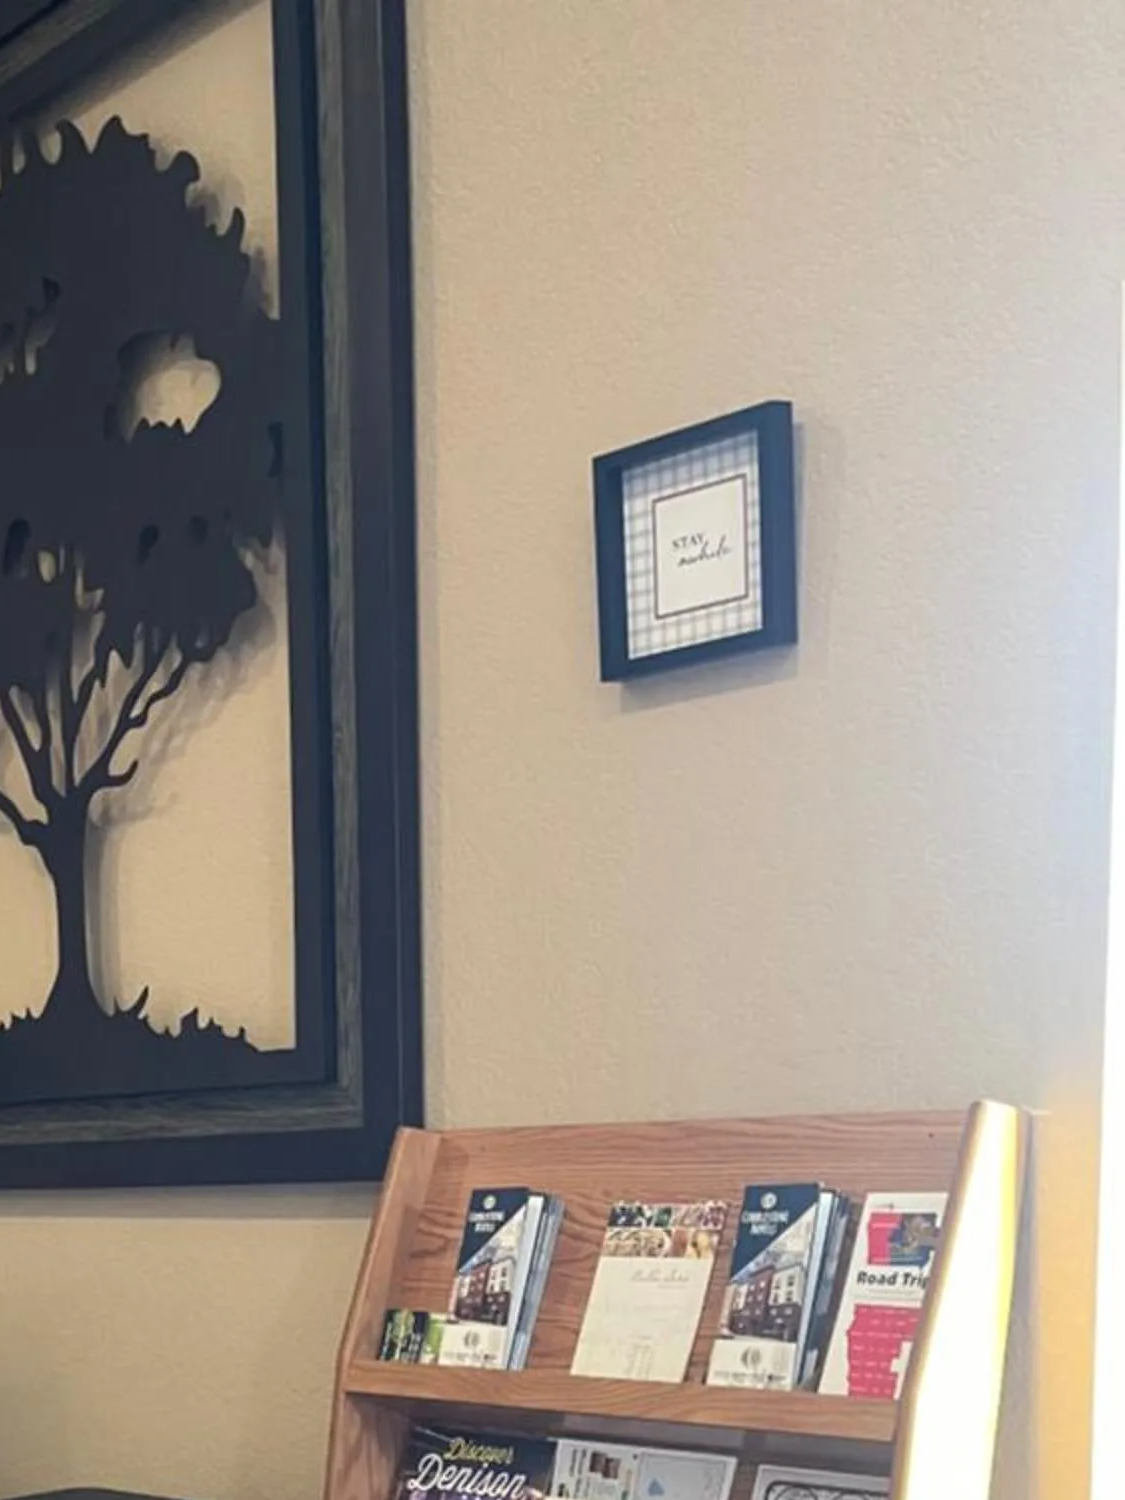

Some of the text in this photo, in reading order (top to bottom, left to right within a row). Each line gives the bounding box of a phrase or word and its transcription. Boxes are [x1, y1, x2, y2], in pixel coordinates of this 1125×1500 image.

[672, 532, 706, 549] STAY
[856, 1269, 898, 1288] Road
[442, 1436, 515, 1465] Discover
[406, 1452, 527, 1500] Denison
